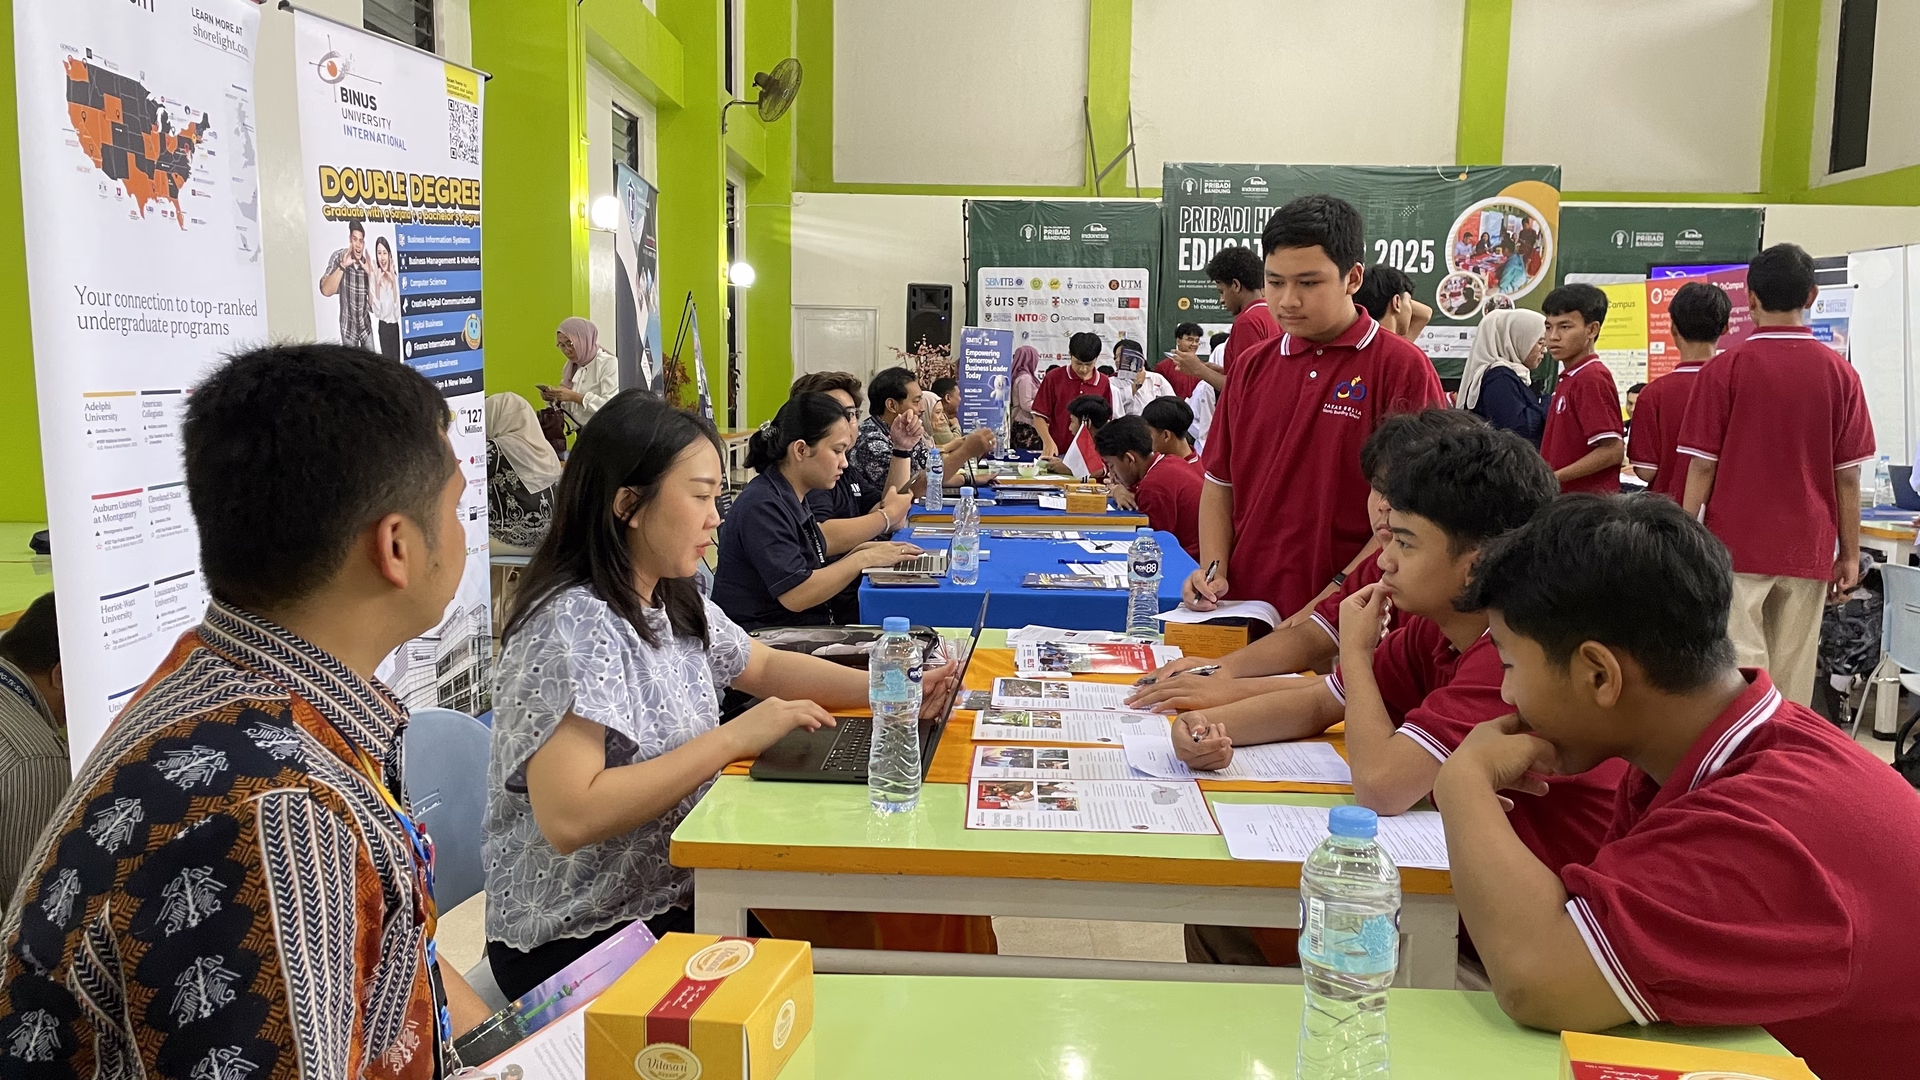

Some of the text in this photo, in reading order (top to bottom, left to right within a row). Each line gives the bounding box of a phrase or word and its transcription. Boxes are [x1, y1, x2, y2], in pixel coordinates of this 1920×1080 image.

[191, 7, 243, 36] LEARN MORE AT
[341, 87, 377, 111] BINUS
[342, 108, 392, 131] UNIVERSITY
[344, 125, 407, 151] INTERNATIONAL
[319, 166, 480, 207] DOUBLE DEGREE
[323, 205, 364, 219] Graduate
[366, 206, 384, 219] with
[424, 210, 460, 221] Bachelor's
[1180, 206, 1251, 234] PRIBADI
[408, 235, 471, 245] Business Information Systems
[409, 256, 425, 265] Business
[1374, 239, 1435, 274] 2025
[410, 278, 447, 288] Computer Science
[1121, 280, 1142, 289] UTM
[74, 285, 258, 318] Your connection to top-ranked
[426, 299, 441, 309] Digital
[442, 297, 476, 306] Communication
[994, 297, 1014, 306] UTS
[1608, 301, 1635, 309] Campus
[425, 319, 444, 328] Business
[1015, 314, 1038, 322] INTO
[77, 310, 230, 339] undergraduate programs
[429, 339, 456, 350] International
[966, 349, 1000, 359] Empowering
[439, 359, 459, 368] Business
[965, 364, 989, 372] Business
[448, 379, 459, 387] New
[459, 376, 473, 385] Media
[965, 372, 982, 381] Today
[84, 402, 111, 411] Adelphi
[85, 413, 118, 422] University
[142, 410, 164, 418] Collegiate
[467, 409, 483, 423] 127
[465, 426, 483, 434] Million
[148, 491, 181, 504] Cleveland State
[93, 498, 143, 514] Auburn University
[148, 503, 171, 514] University
[93, 510, 137, 524] at Montgomery
[154, 582, 188, 598] Louisiana State
[100, 598, 136, 614] Heriot-Watt
[155, 595, 178, 608] University
[101, 610, 132, 625] University
[647, 1057, 688, 1073] Vitasari
